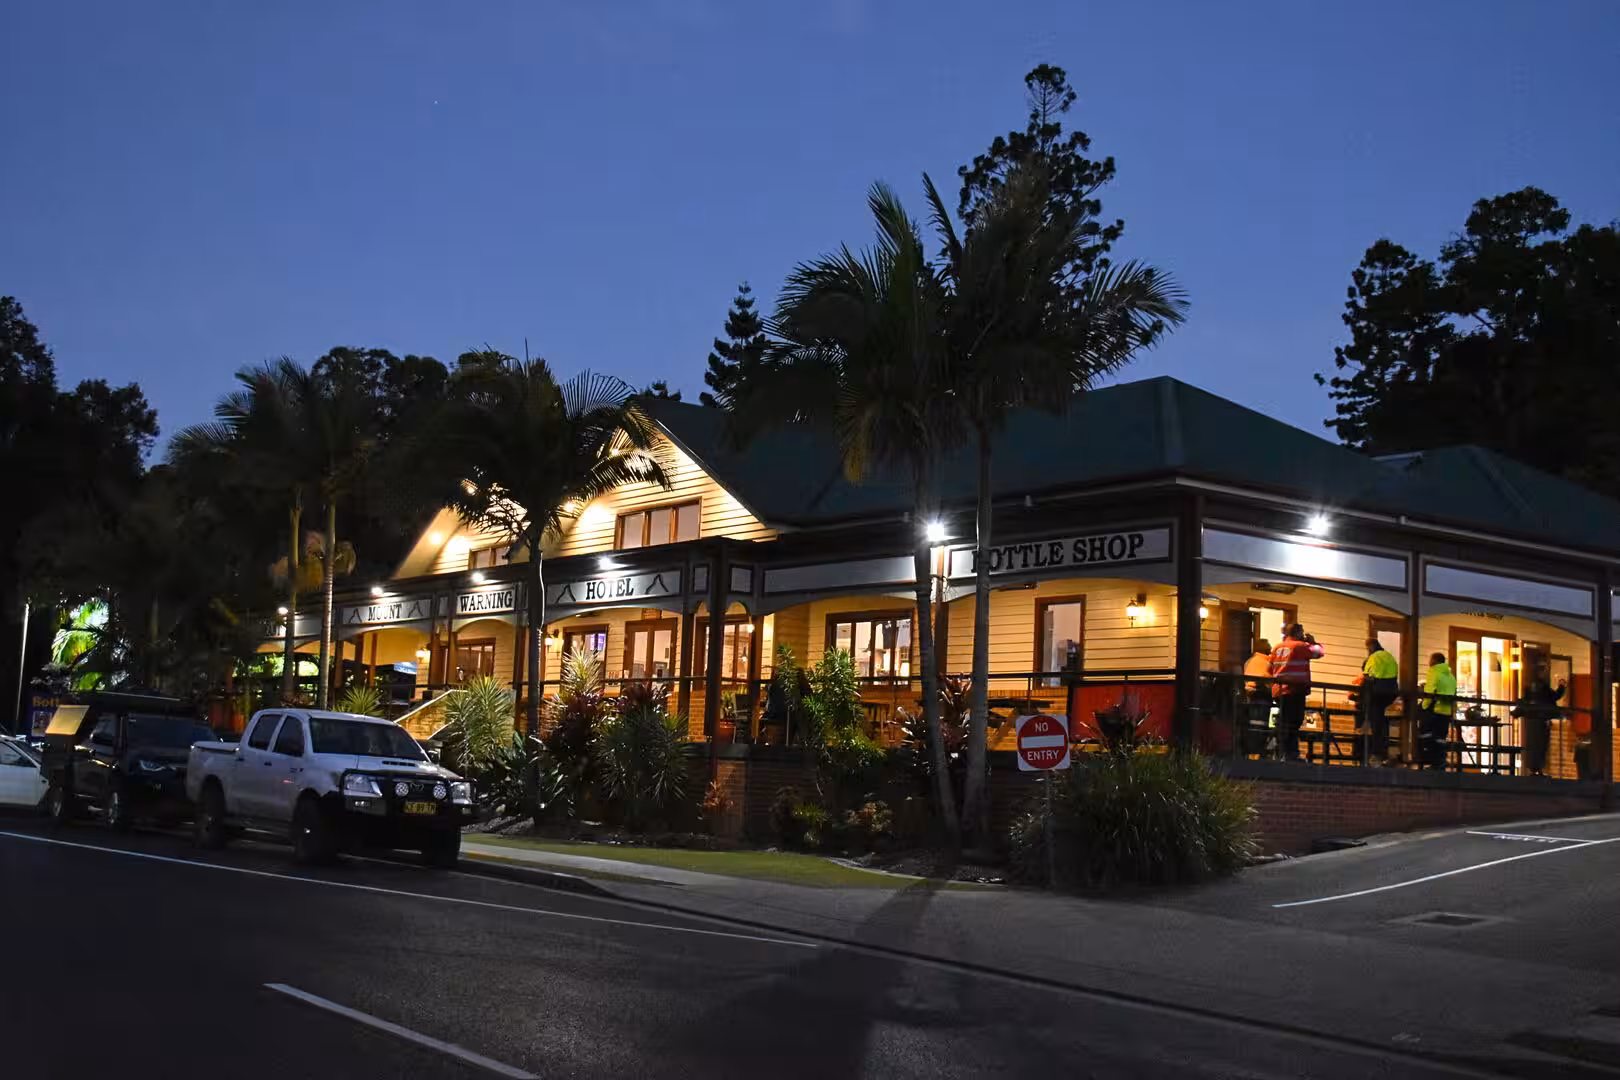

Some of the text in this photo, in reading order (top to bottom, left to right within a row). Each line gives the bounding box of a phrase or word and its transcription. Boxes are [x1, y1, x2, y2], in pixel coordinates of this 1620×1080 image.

[1072, 533, 1145, 563] SHOP
[586, 577, 634, 600] HOTEL
[460, 591, 513, 612] WARNING
[368, 603, 402, 622] MOUNT
[1034, 722, 1049, 732] NO
[1027, 749, 1059, 761] ENTRY
